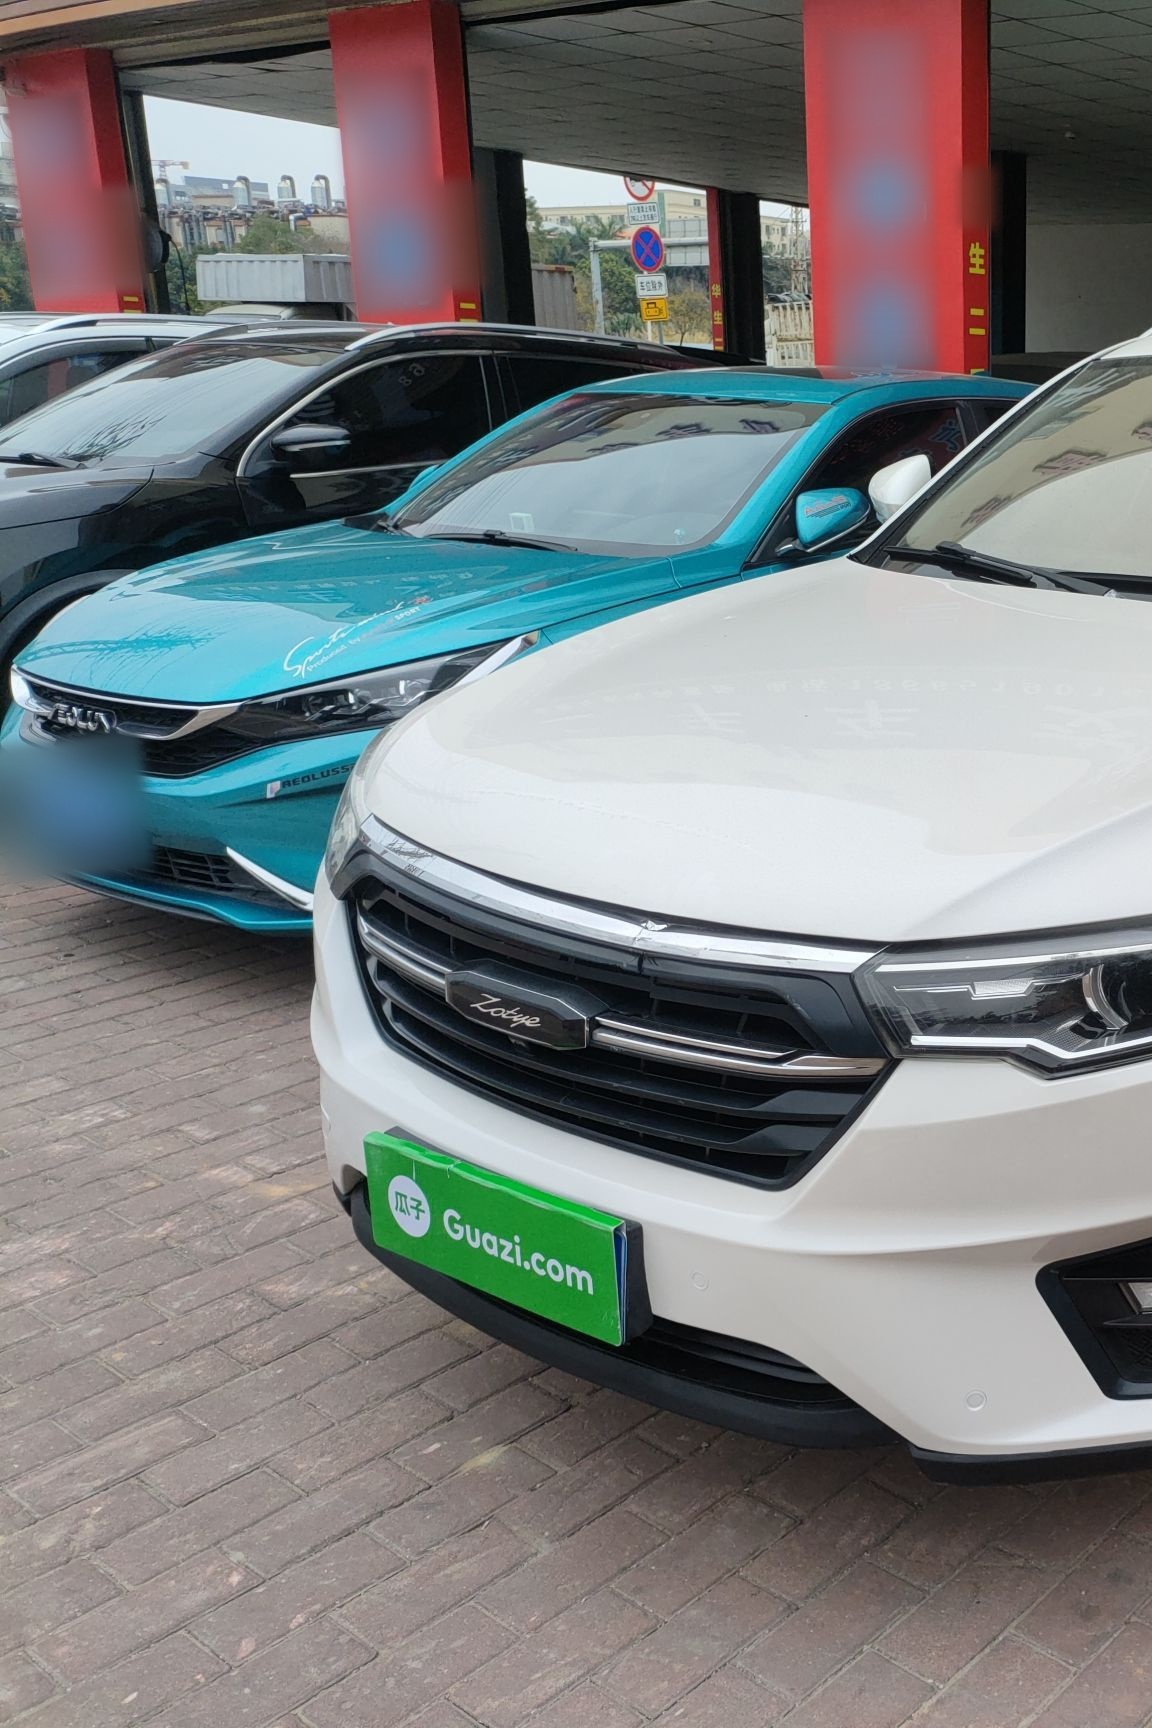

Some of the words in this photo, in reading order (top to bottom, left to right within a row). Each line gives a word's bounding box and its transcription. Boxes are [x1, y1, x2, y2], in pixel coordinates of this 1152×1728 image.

[470, 993, 541, 1028] Zotye
[394, 1190, 426, 1221] 瓜子
[442, 1208, 594, 1296] Guazi.com
